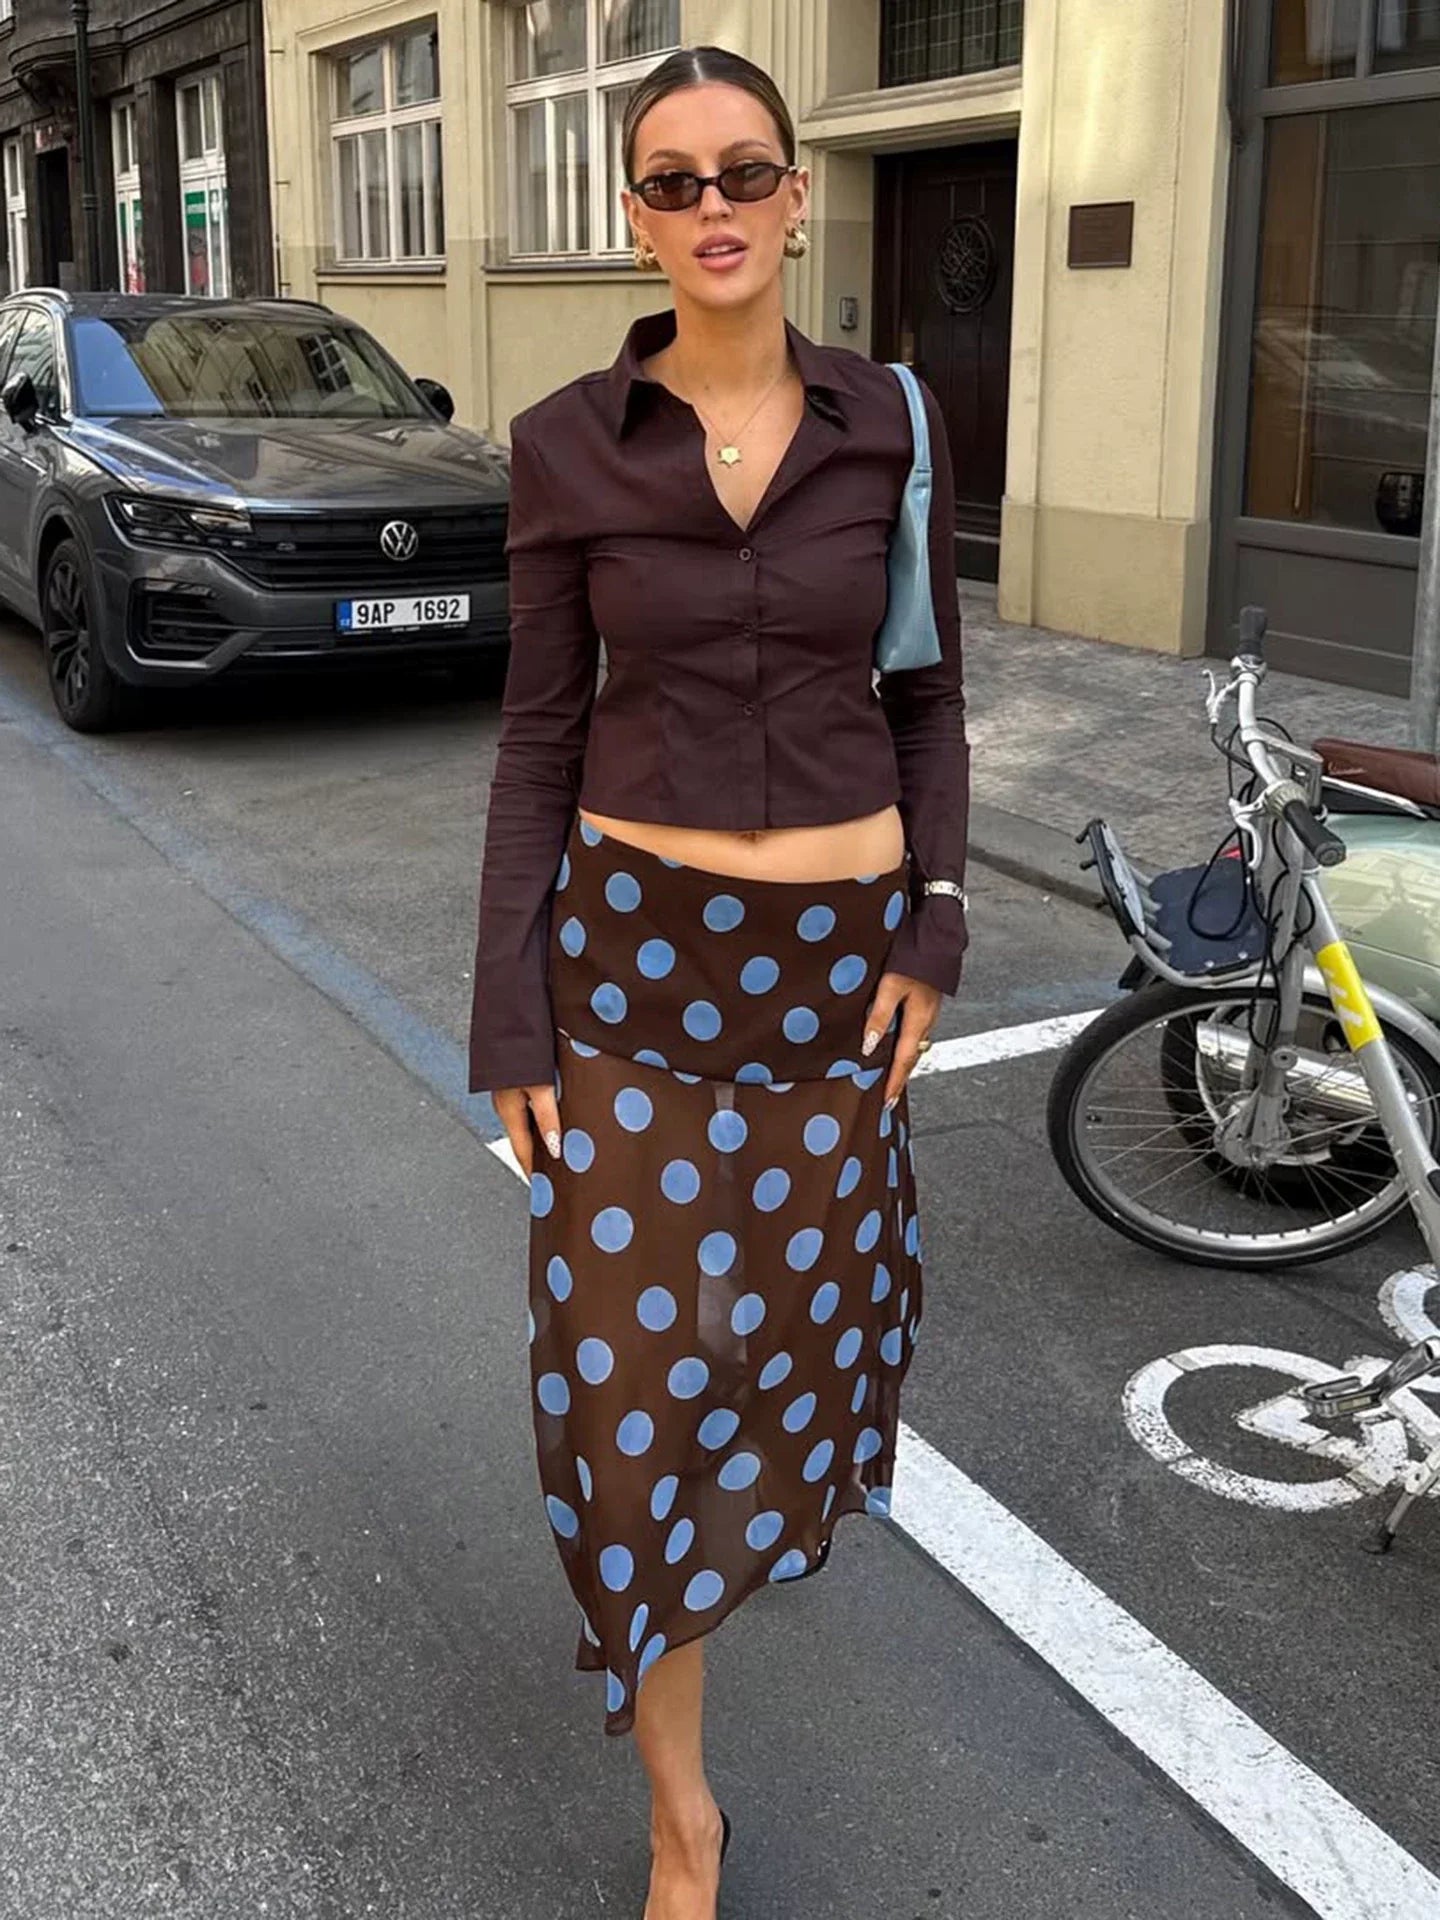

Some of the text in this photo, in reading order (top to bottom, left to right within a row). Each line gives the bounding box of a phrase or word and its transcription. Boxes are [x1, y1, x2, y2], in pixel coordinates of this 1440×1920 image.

[382, 521, 417, 559] VW
[357, 598, 460, 625] 9AP 1692
